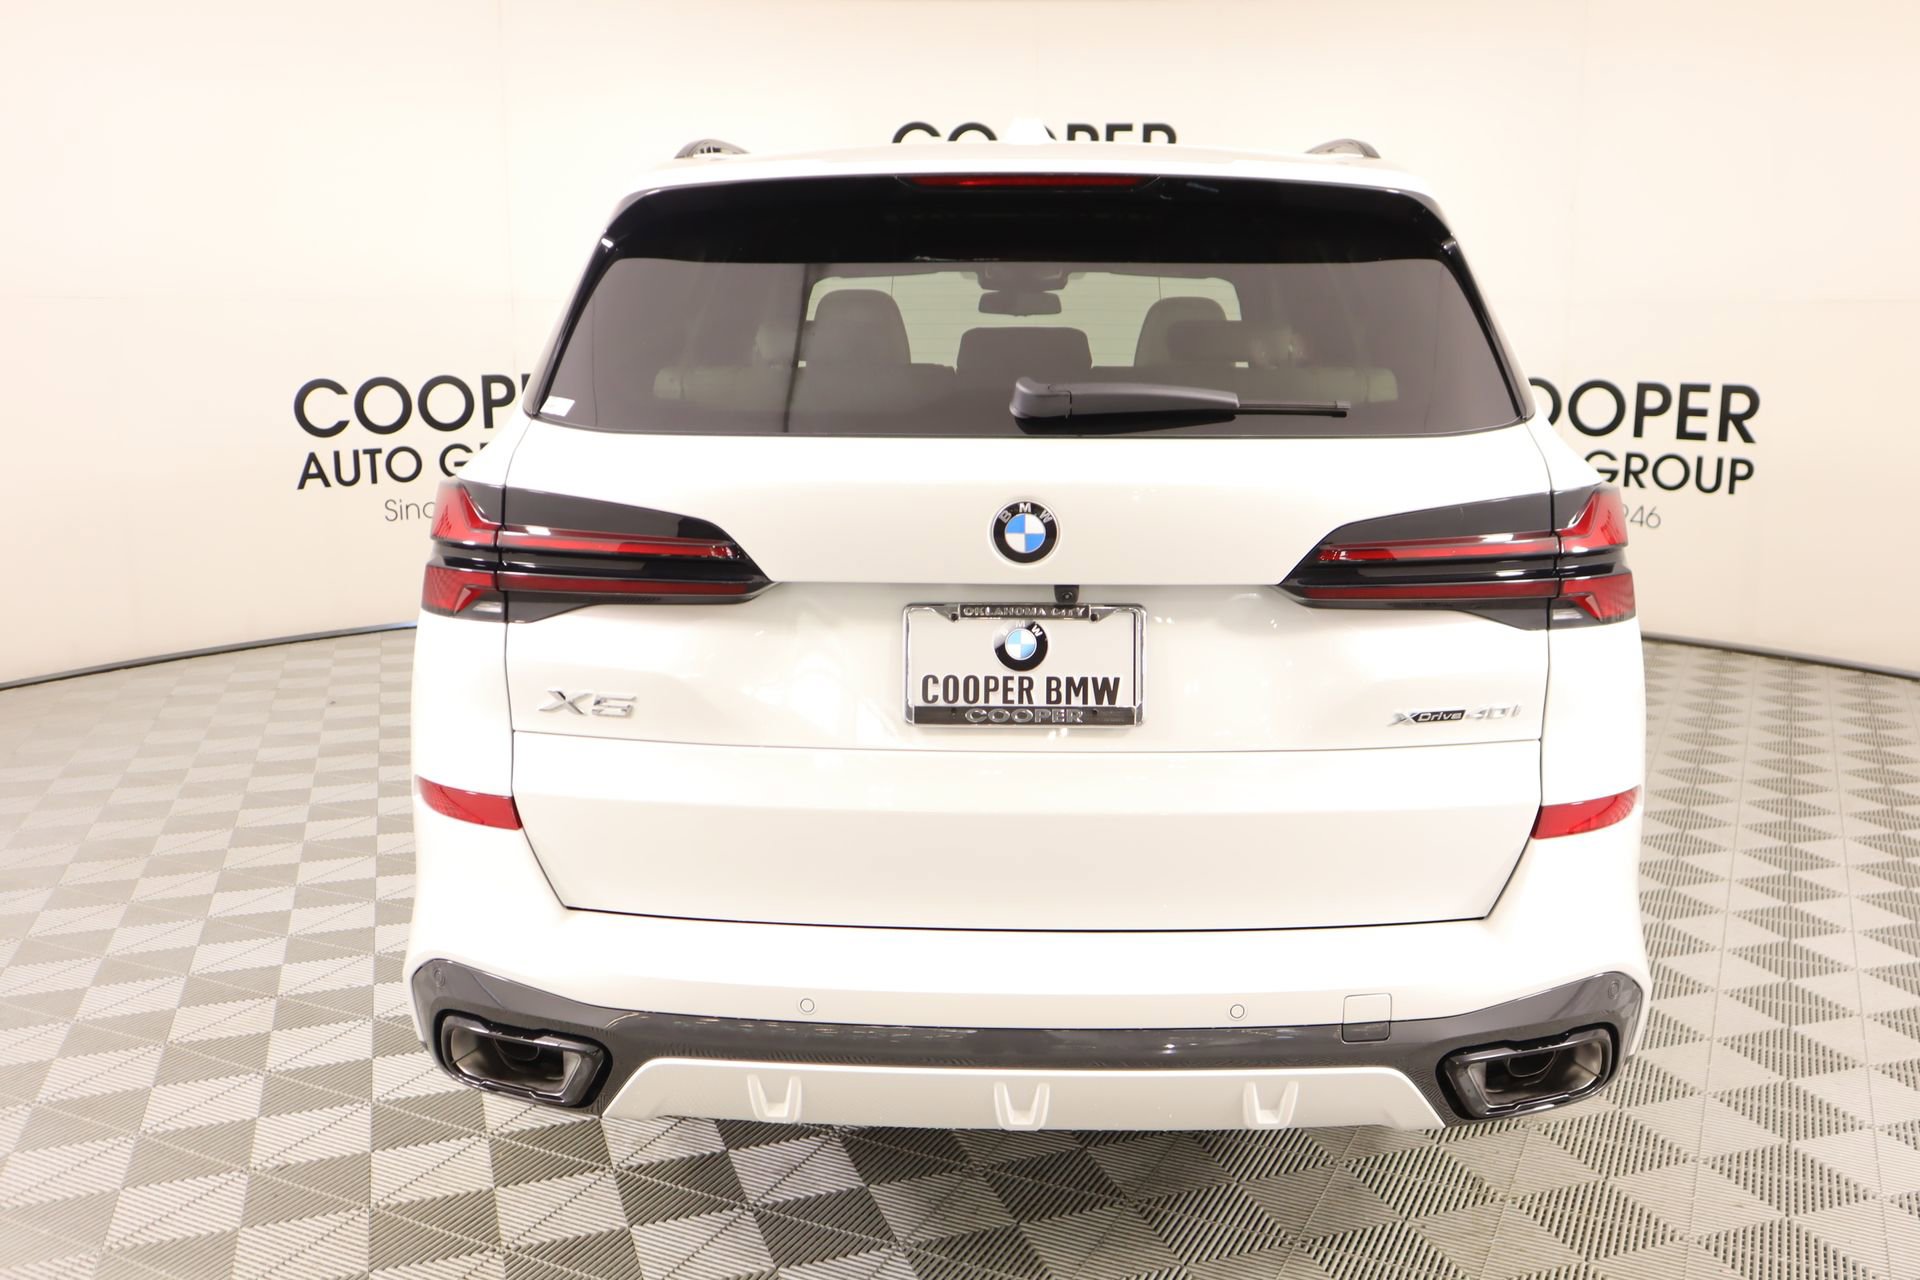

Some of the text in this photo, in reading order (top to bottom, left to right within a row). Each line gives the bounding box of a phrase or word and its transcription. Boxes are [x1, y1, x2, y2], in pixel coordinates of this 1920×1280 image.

[294, 374, 529, 438] COOP
[297, 446, 422, 490] AUTO
[1585, 450, 1754, 495] GROUP
[384, 499, 434, 522] Sinc
[999, 503, 1053, 523] BMW
[963, 605, 1085, 617] OKLAHOMA CITY
[537, 688, 637, 718] X5
[921, 674, 1121, 706] COOPER BMW
[965, 708, 1084, 723] COOPER
